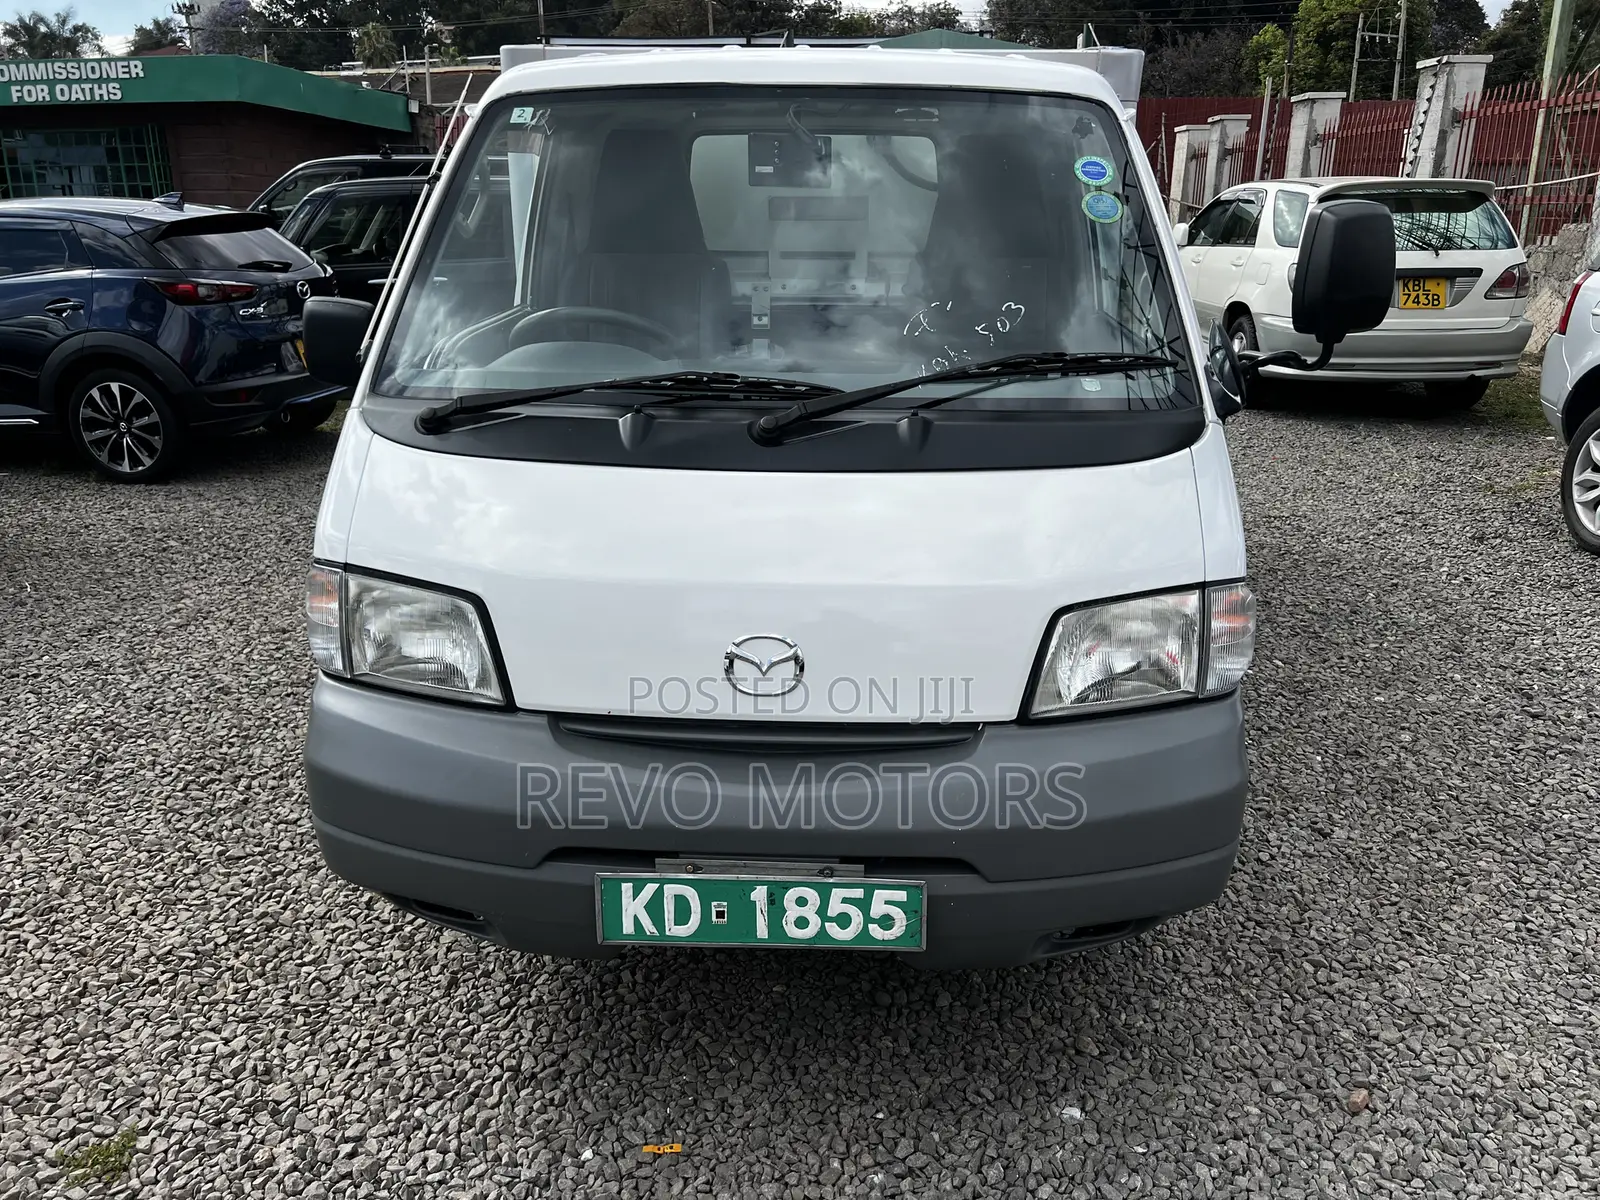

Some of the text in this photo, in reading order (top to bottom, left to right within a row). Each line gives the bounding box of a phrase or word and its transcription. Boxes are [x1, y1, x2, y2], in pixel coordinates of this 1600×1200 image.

[10, 82, 122, 103] FOR OATHS
[1402, 278, 1431, 292] KBL
[1402, 293, 1441, 307] 743B
[620, 882, 908, 942] KD 1855
